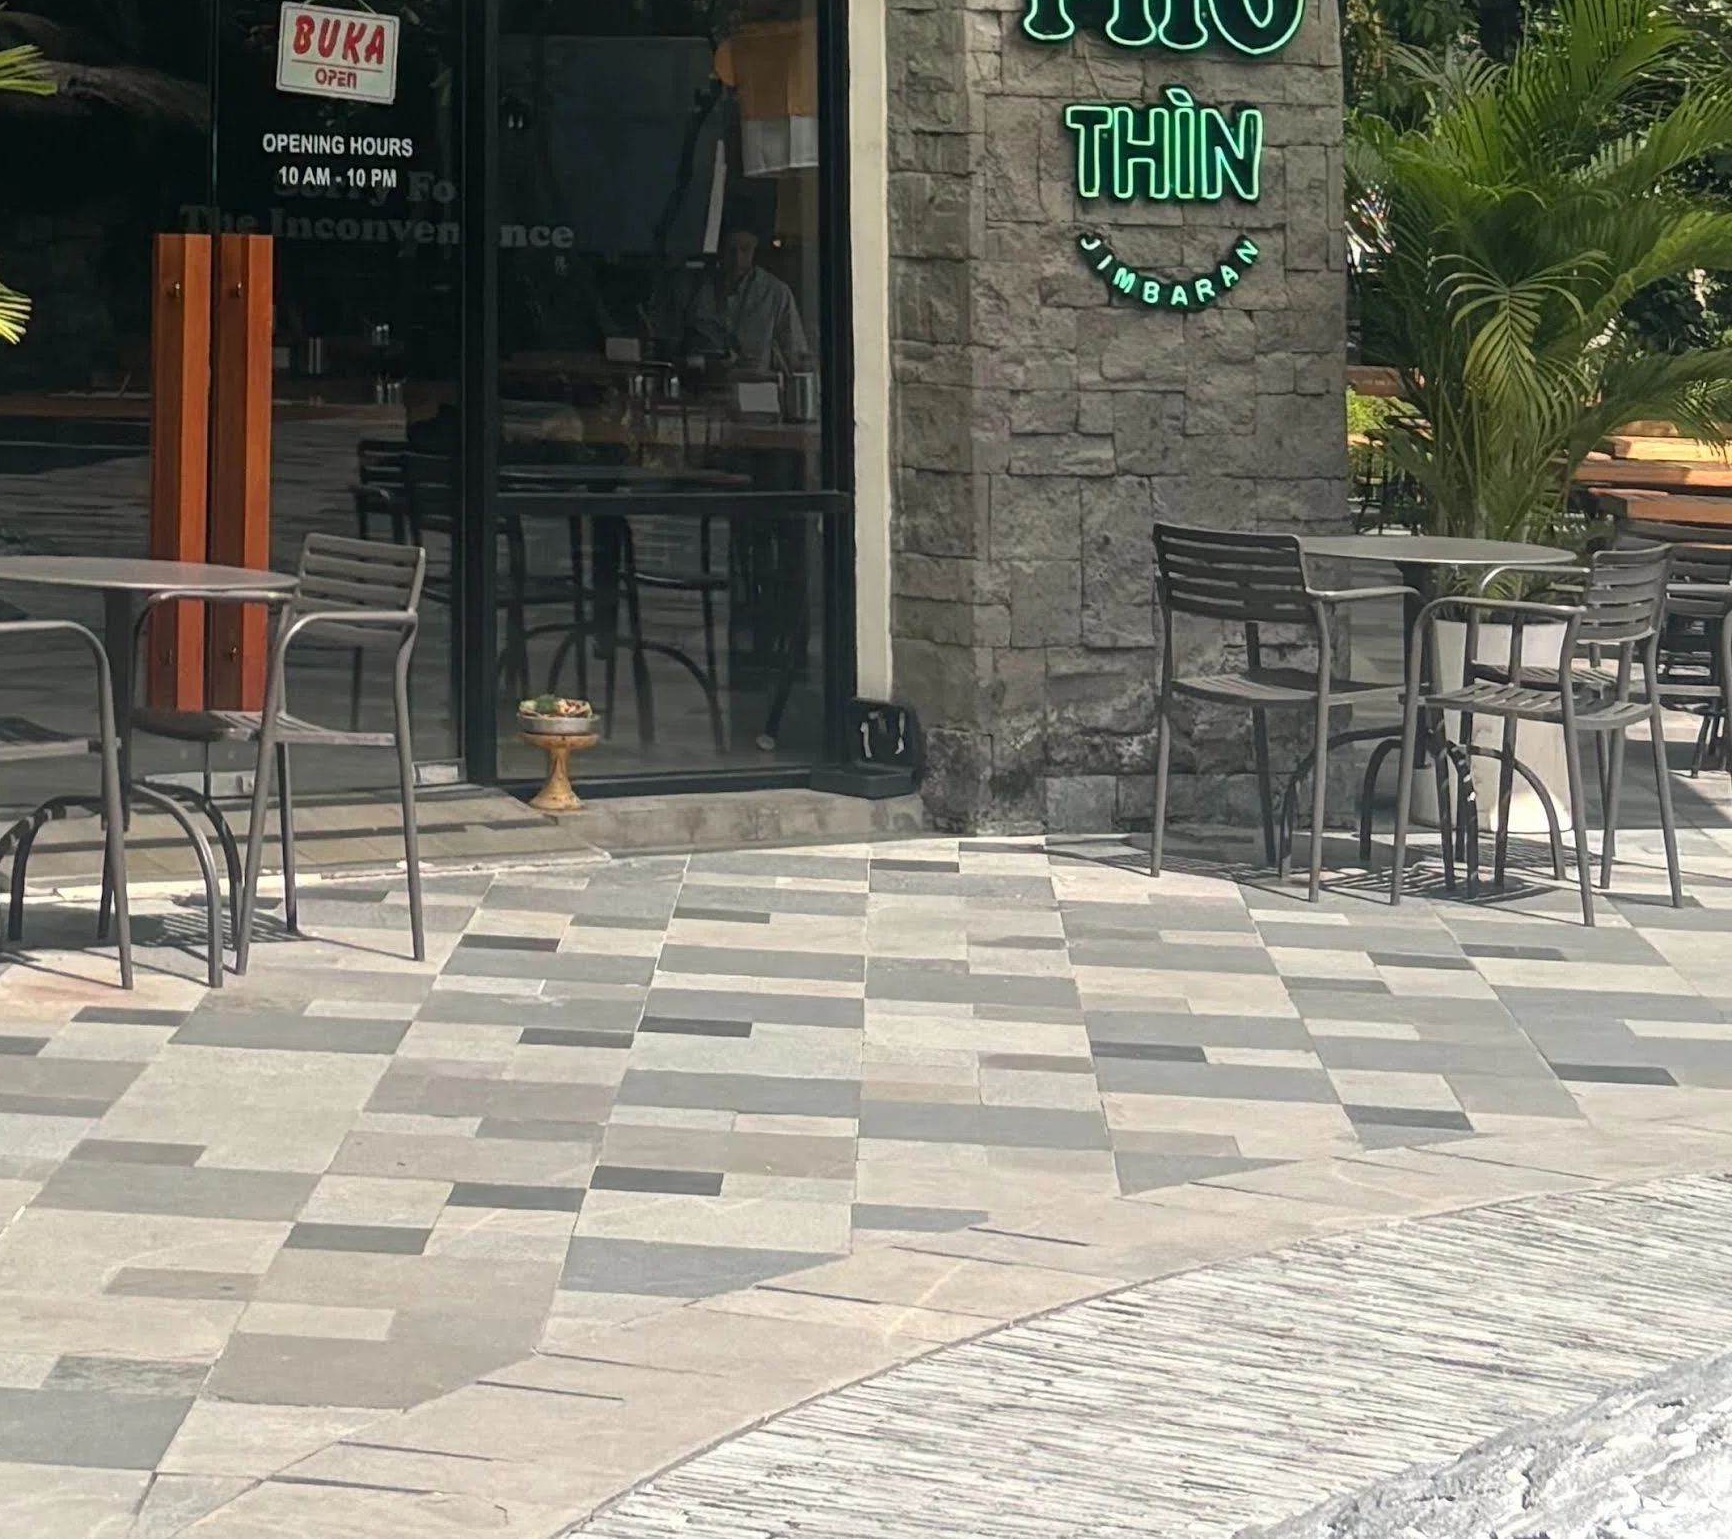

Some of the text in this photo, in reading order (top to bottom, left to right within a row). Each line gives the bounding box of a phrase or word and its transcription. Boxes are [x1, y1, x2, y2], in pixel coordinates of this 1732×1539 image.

[293, 15, 386, 66] BUKA
[315, 67, 357, 89] OPEN
[262, 133, 413, 158] OPENING HOURS
[278, 166, 299, 185] 10
[302, 167, 331, 187] AM
[346, 168, 366, 187] 10
[371, 168, 397, 188] PM
[407, 171, 458, 203] Fo
[1079, 234, 1261, 307] JIMBARAN
